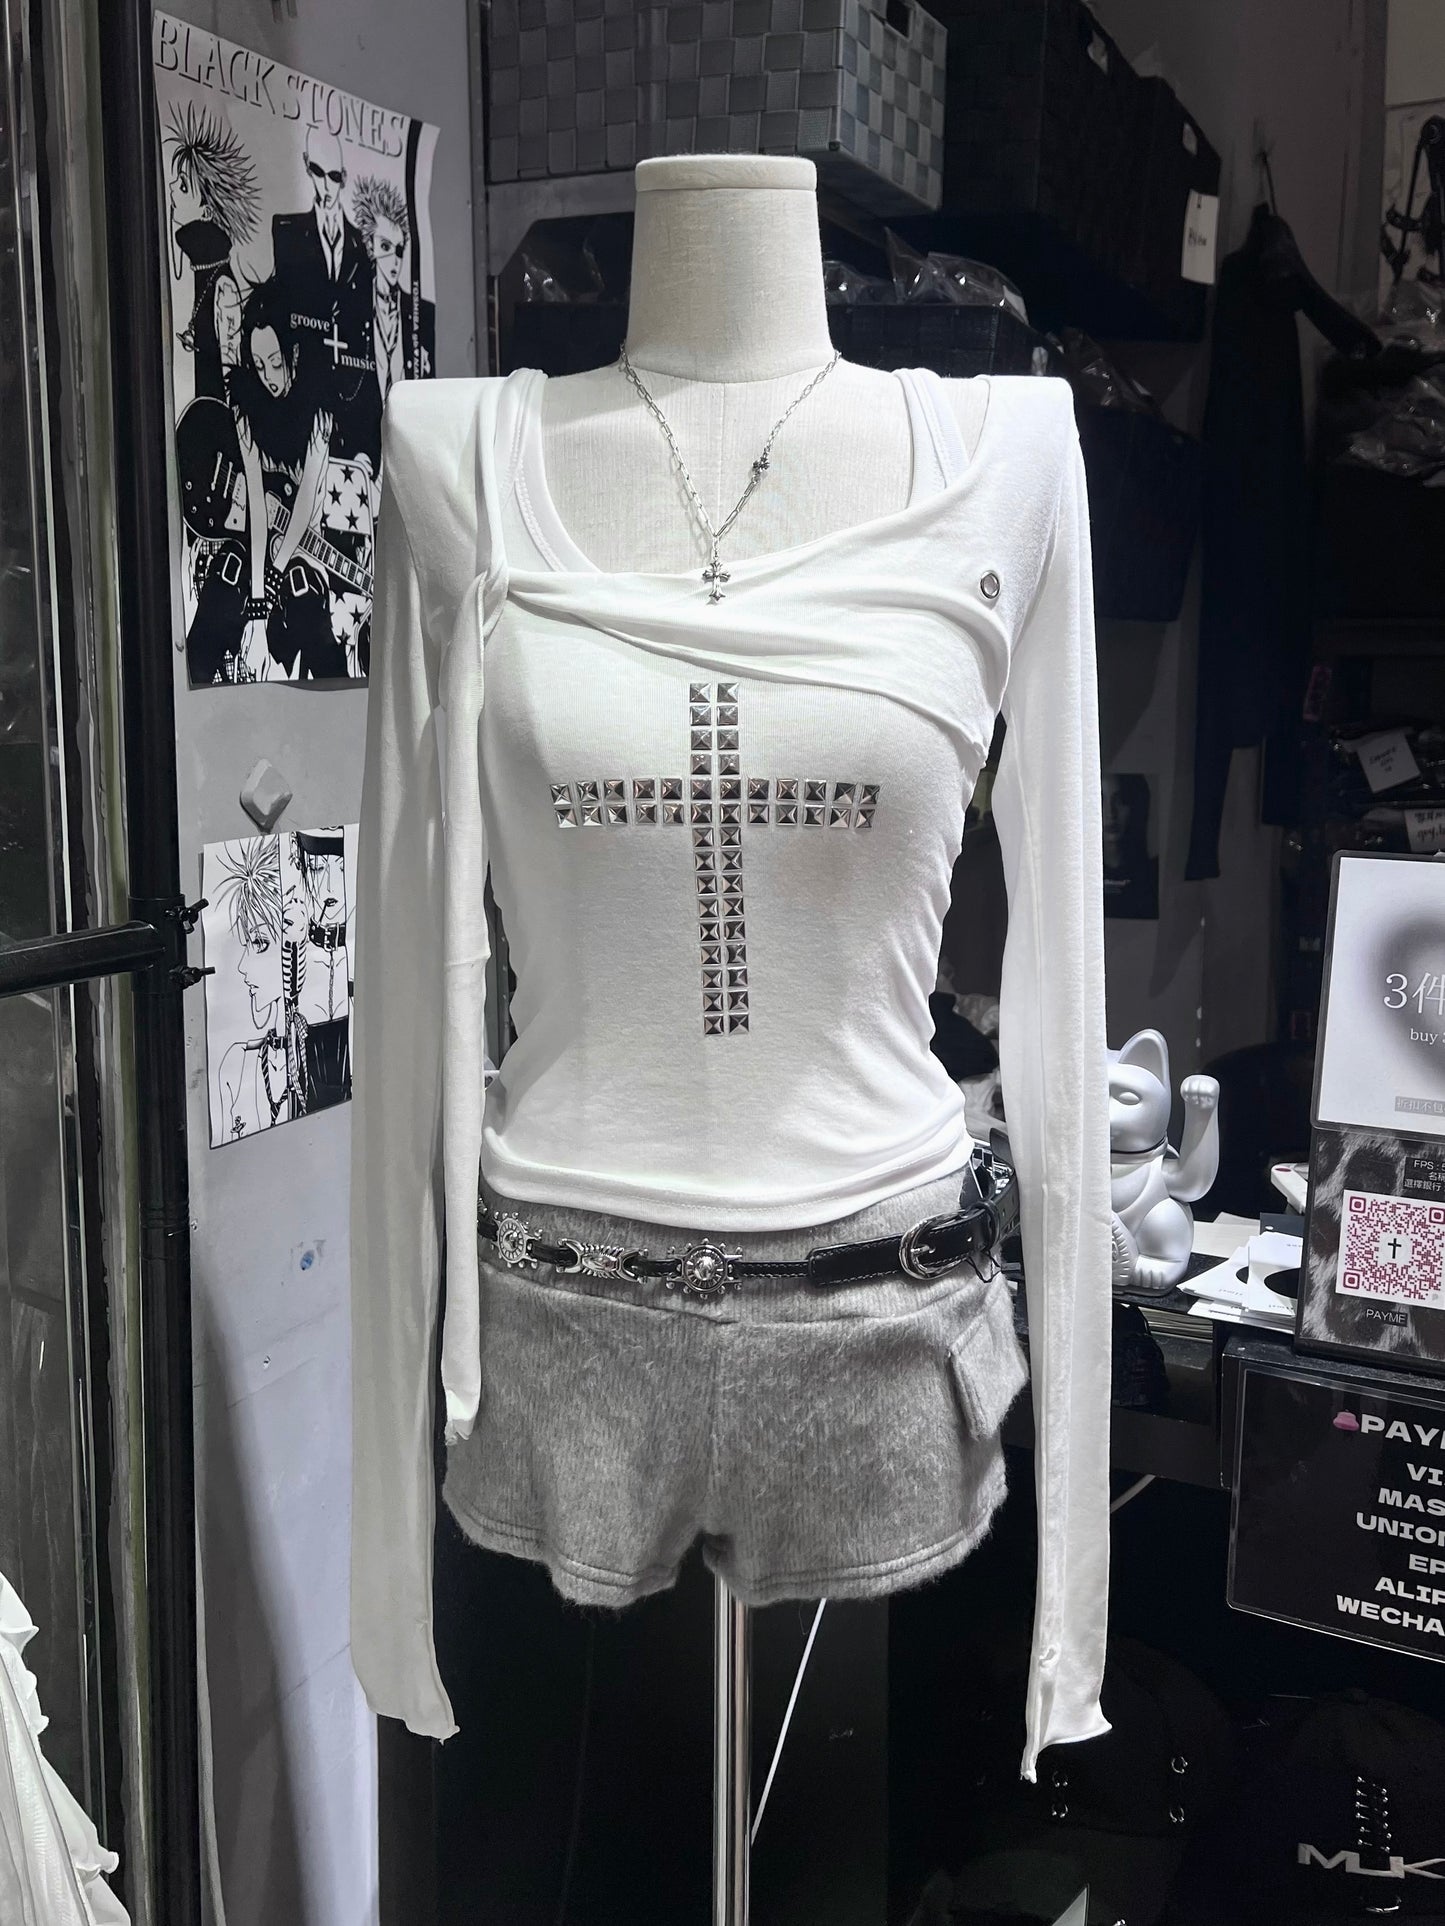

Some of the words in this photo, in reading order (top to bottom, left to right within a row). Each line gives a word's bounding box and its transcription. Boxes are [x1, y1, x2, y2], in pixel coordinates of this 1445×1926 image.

[155, 19, 275, 115] BLACK
[283, 74, 404, 158] STONES
[290, 313, 330, 332] groove
[341, 354, 376, 371] music
[1410, 1027, 1438, 1045] buy
[1366, 1308, 1406, 1324] PAYME
[1361, 1413, 1445, 1450] PAY
[1406, 1462, 1445, 1486] VI
[1378, 1487, 1445, 1517] MAS
[1409, 1553, 1445, 1575] EP
[1336, 1594, 1445, 1637] WECHA
